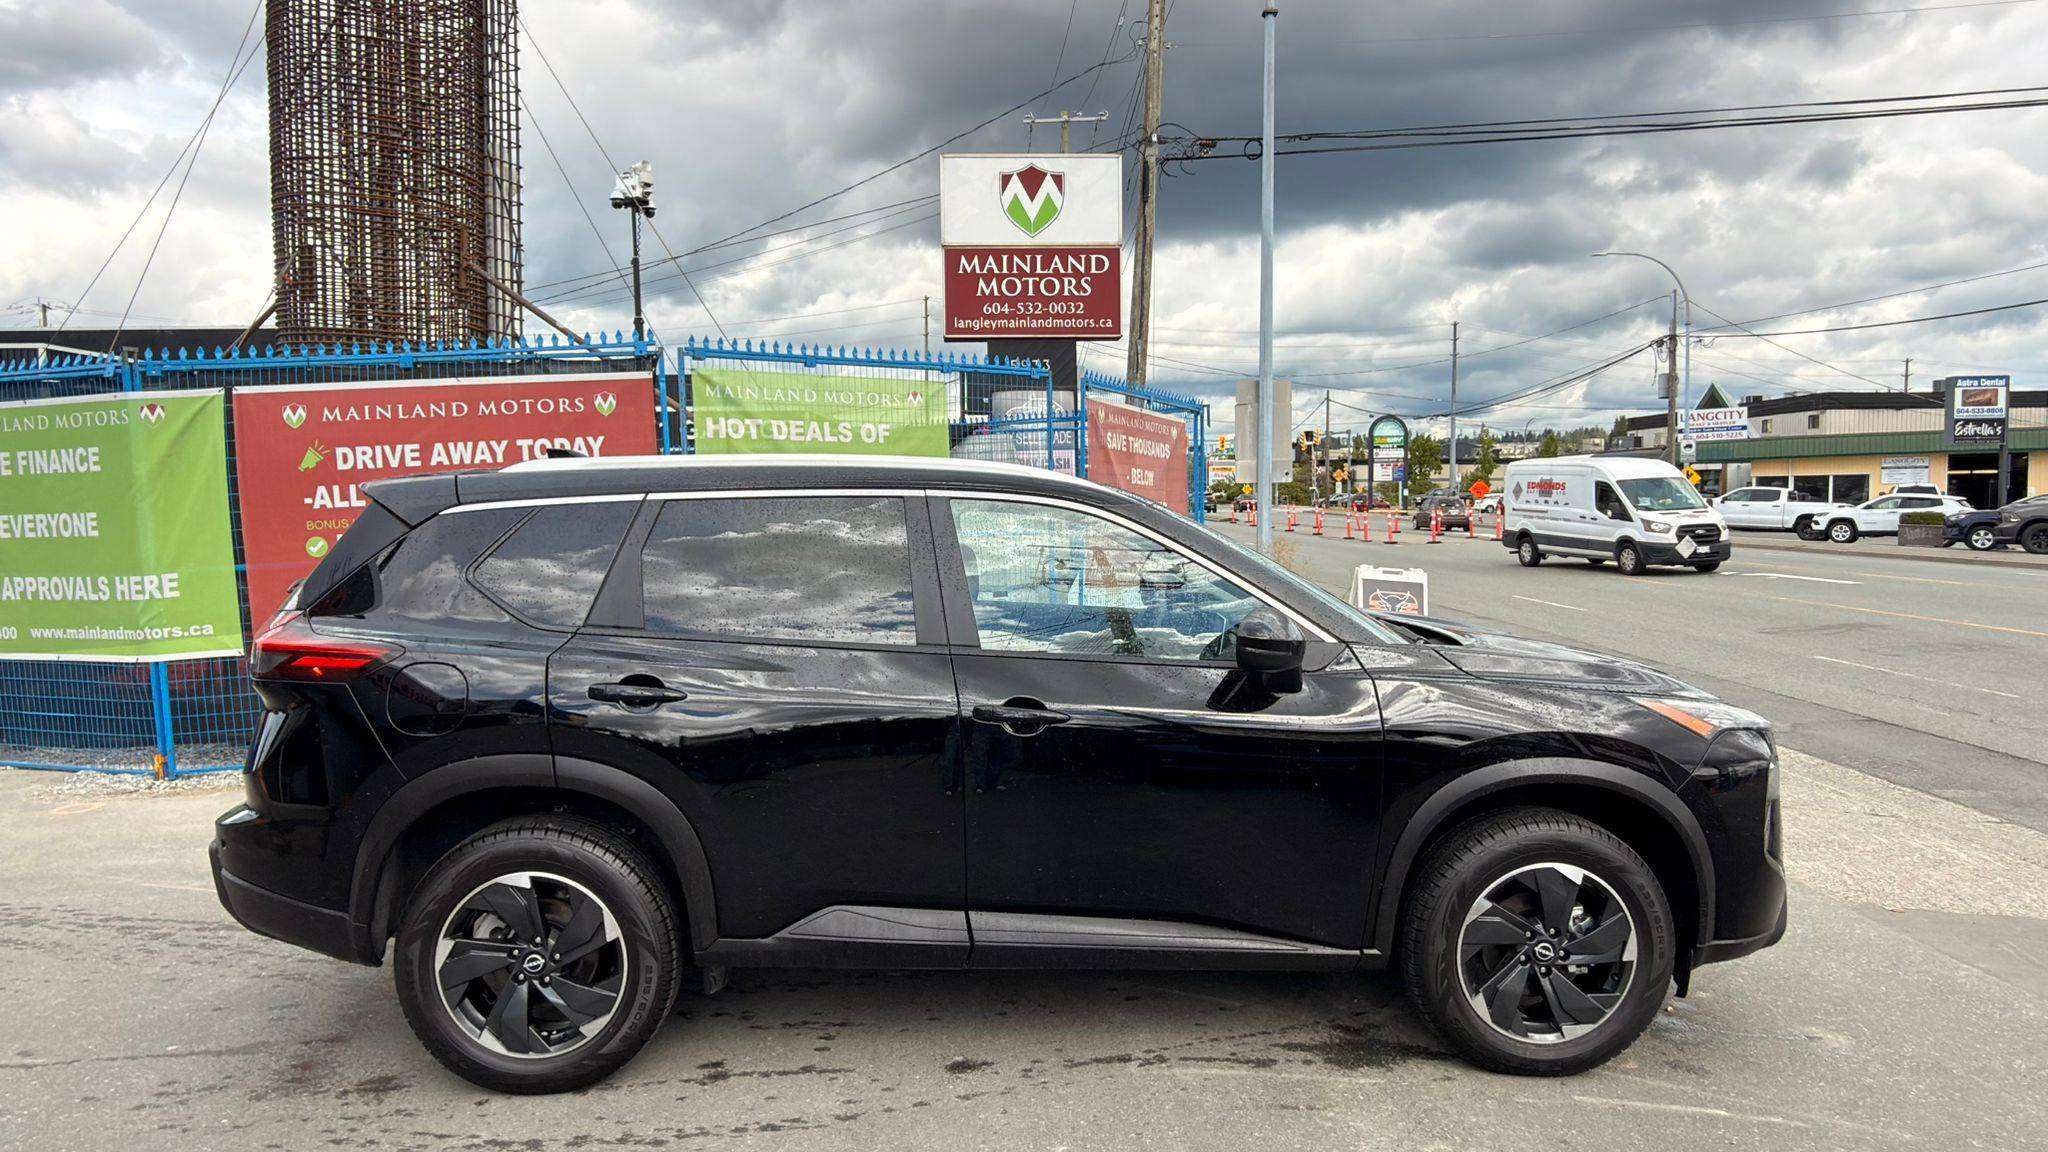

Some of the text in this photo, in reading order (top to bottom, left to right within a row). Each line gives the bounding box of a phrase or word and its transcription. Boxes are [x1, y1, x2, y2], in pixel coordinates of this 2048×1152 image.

[958, 254, 1110, 274] MAINLAND
[976, 276, 1092, 296] MOTORS
[983, 302, 1085, 315] 604-532-0032
[954, 317, 1113, 330] langleymainlandmotors.ca
[1957, 378, 2006, 387] Astra Dental
[706, 384, 901, 407] MAINLAND MOTORS
[322, 398, 585, 422] MAINLAND MOTORS
[1681, 410, 1744, 421] LANGCITY
[0, 409, 129, 432] LAND MOTORS
[706, 417, 890, 443] HOT DEALS OF
[1108, 413, 1170, 436] MAINLAND MOTORS
[1955, 421, 2002, 436] Estrella's
[335, 444, 422, 471] DRIVE
[429, 439, 508, 467] AWAY
[1107, 431, 1171, 460] SAVE THOUSANDS
[17, 447, 102, 475] FINANCE
[1131, 467, 1154, 486] BELOW
[1527, 482, 1566, 490] EDMONDS
[0, 512, 99, 539] EVERYONE
[306, 518, 349, 531] BONUS
[2, 572, 180, 601] APPROVALS HERE
[30, 624, 214, 641] www.mainlandmotors.ca
